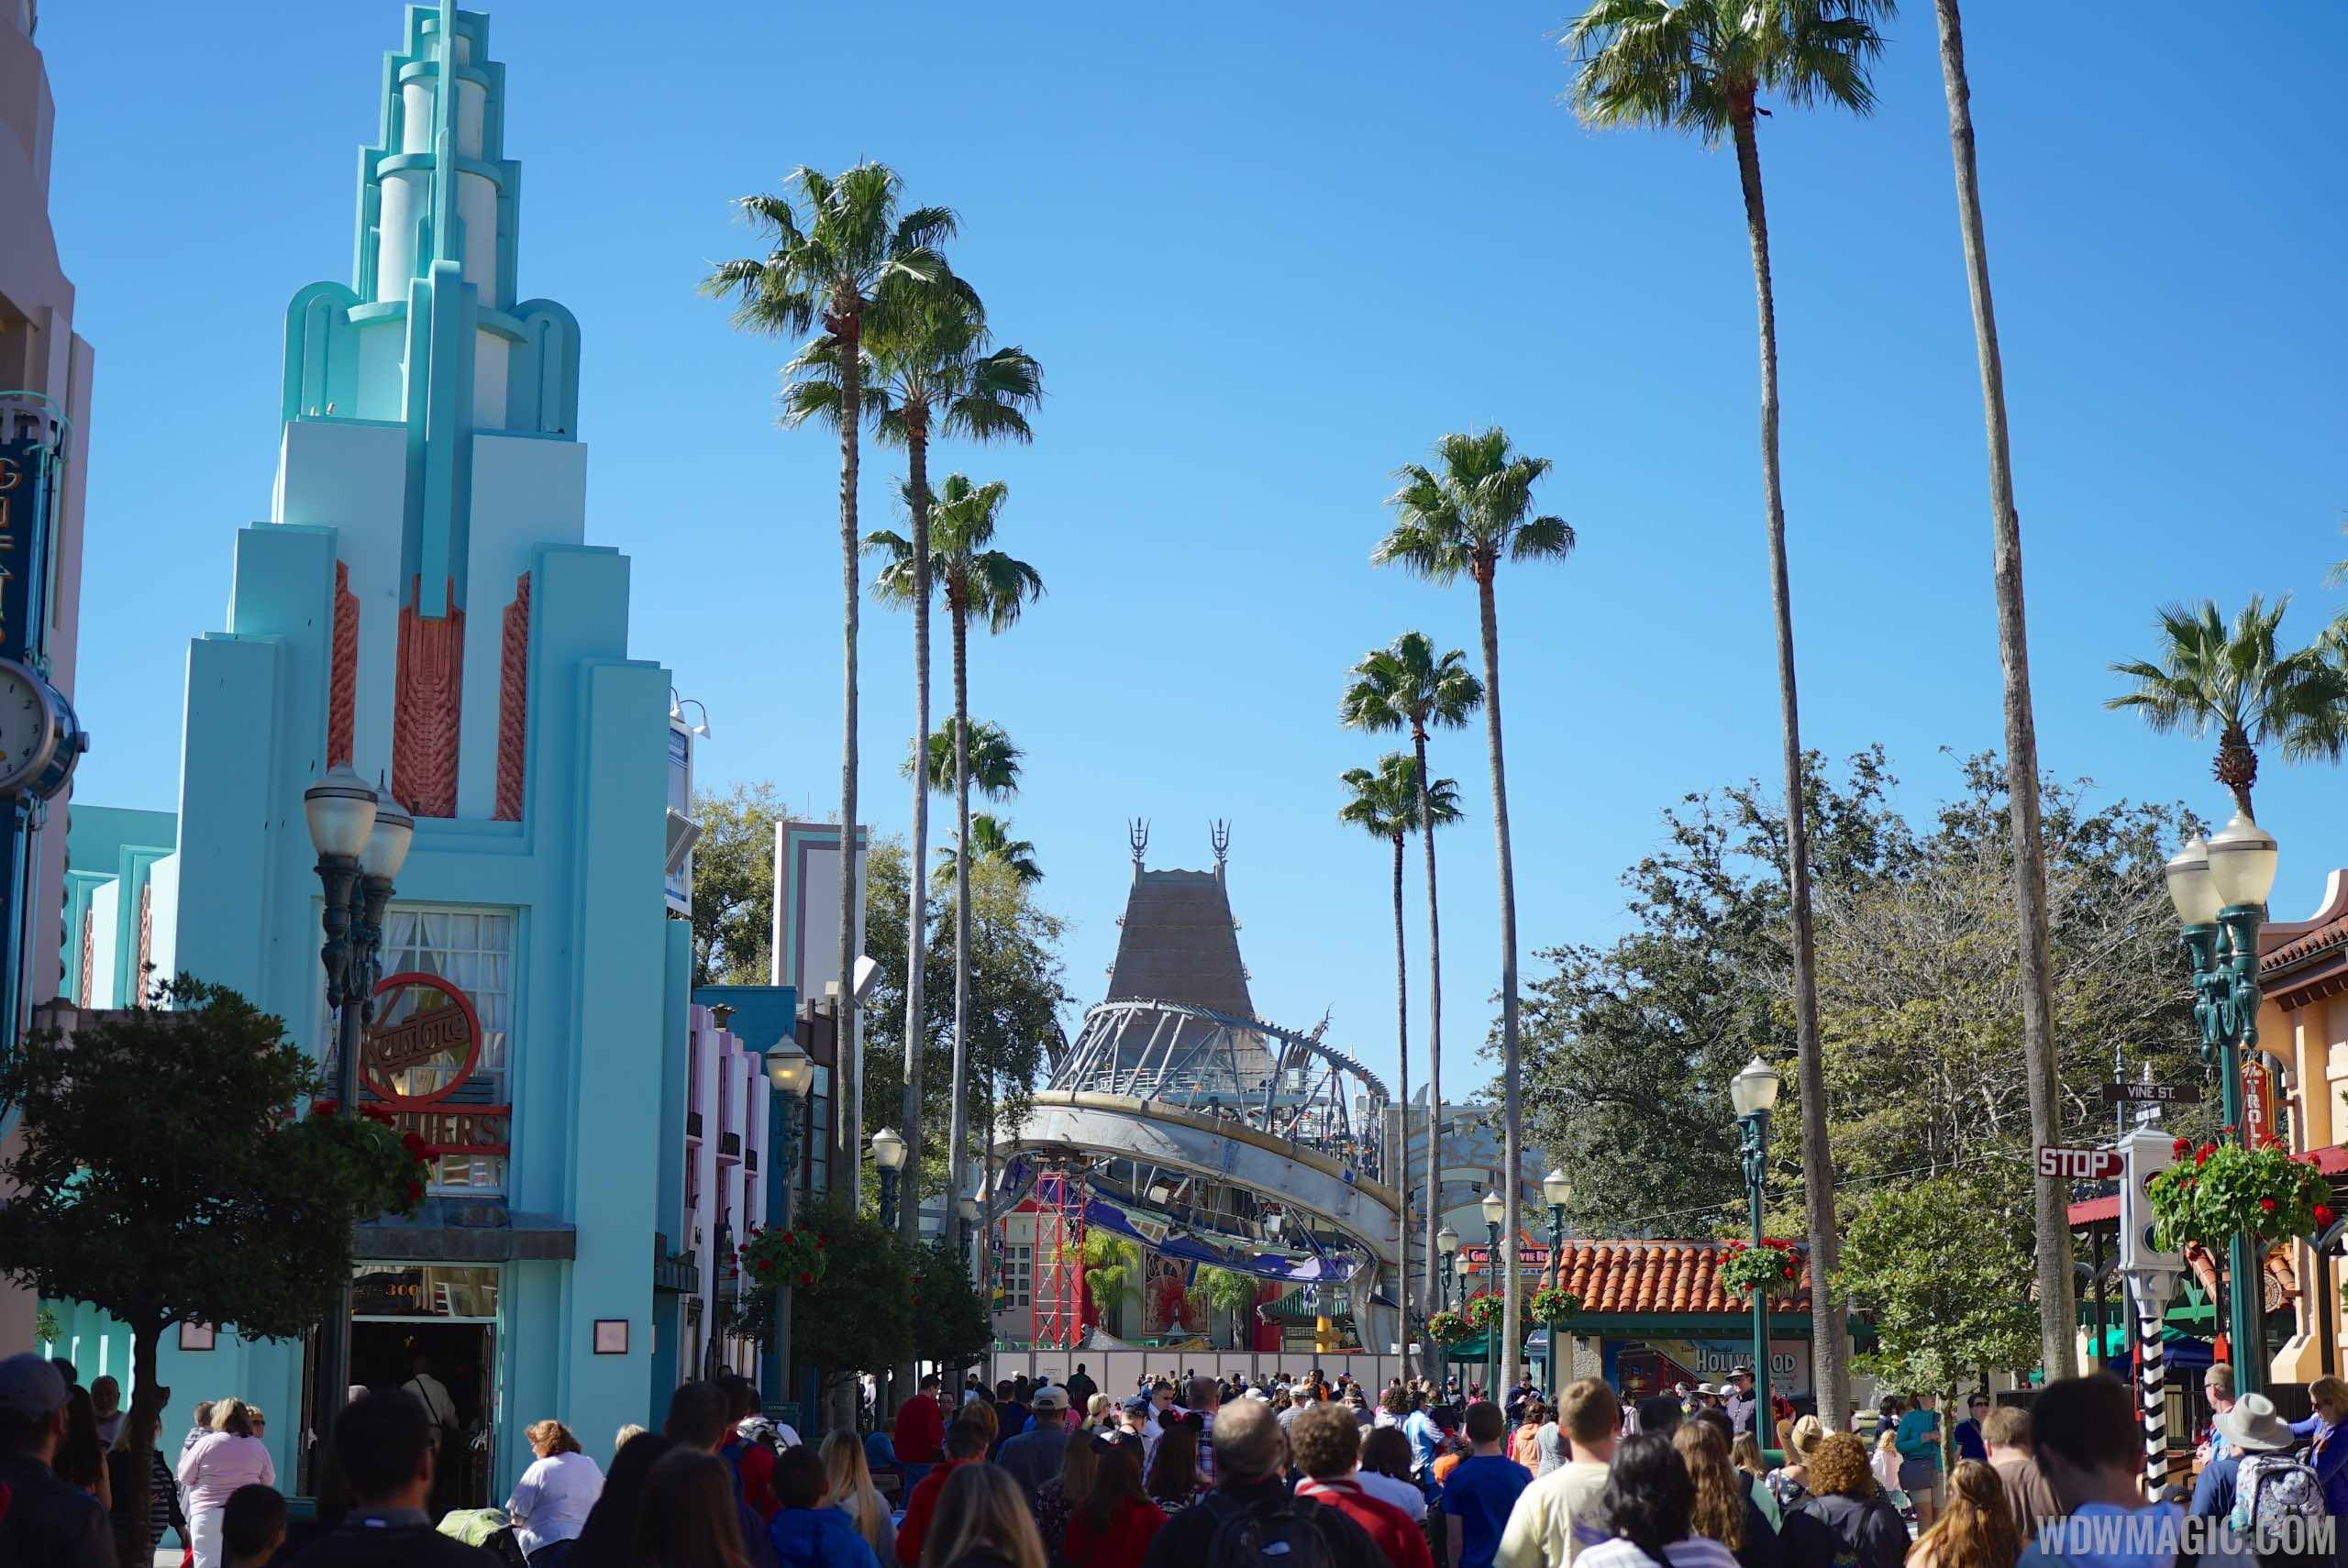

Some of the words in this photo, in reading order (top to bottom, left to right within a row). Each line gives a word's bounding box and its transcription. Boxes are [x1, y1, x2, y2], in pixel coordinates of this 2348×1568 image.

[2127, 1086, 2154, 1099] VINE
[2158, 1087, 2176, 1099] ST.
[2040, 1147, 2110, 1178] STOP
[385, 1284, 418, 1297] 300
[1696, 1349, 1798, 1374] HOLLYWOD
